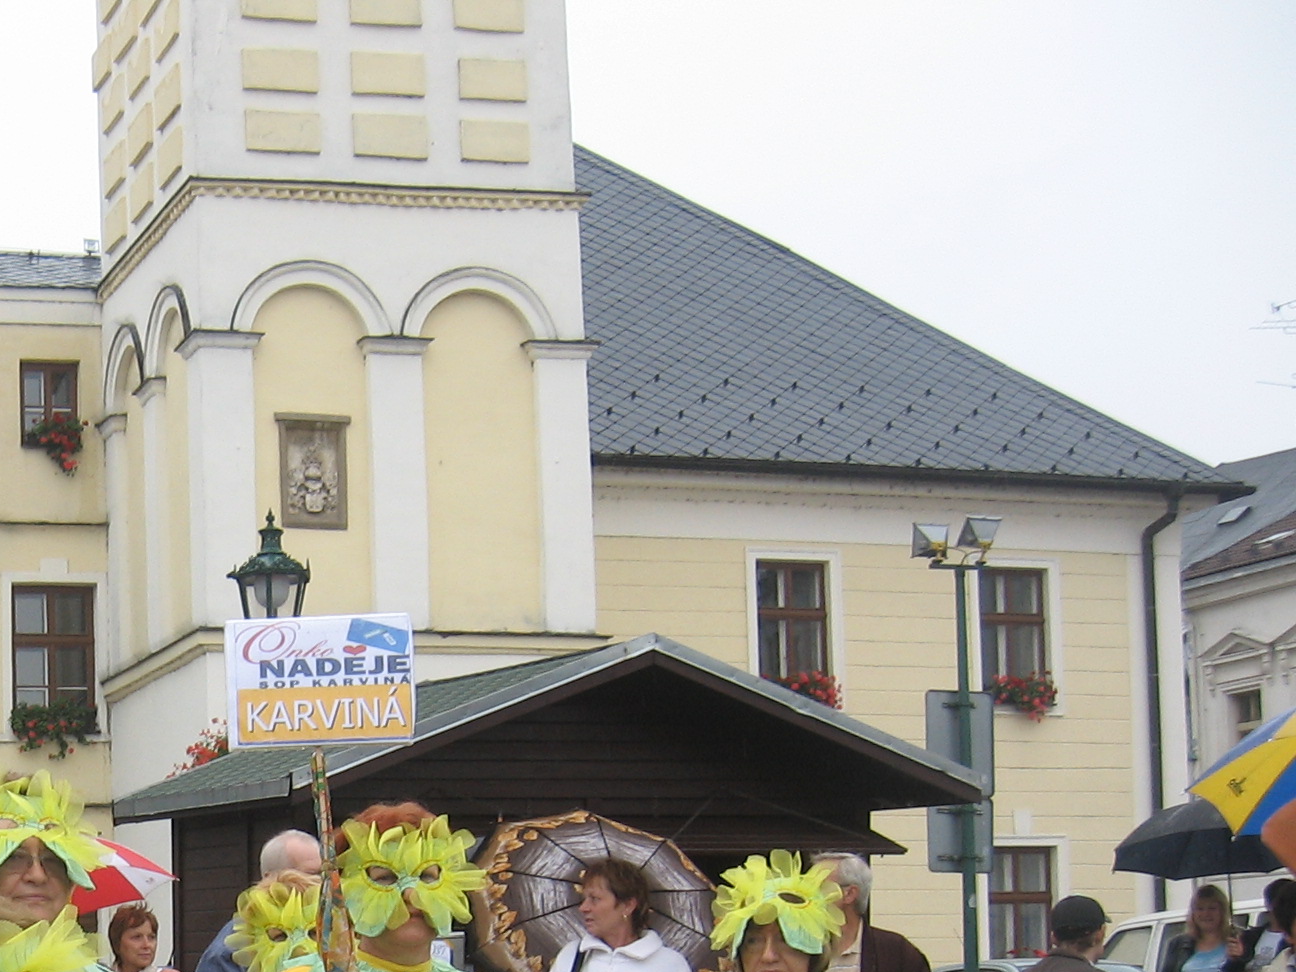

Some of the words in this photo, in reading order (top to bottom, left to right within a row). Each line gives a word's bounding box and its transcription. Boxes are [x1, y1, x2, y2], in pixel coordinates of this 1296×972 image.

[235, 620, 334, 665] Onko
[259, 680, 301, 690] SOP
[312, 672, 411, 688] KARVINÁ
[246, 687, 407, 732] KARVINÁ
